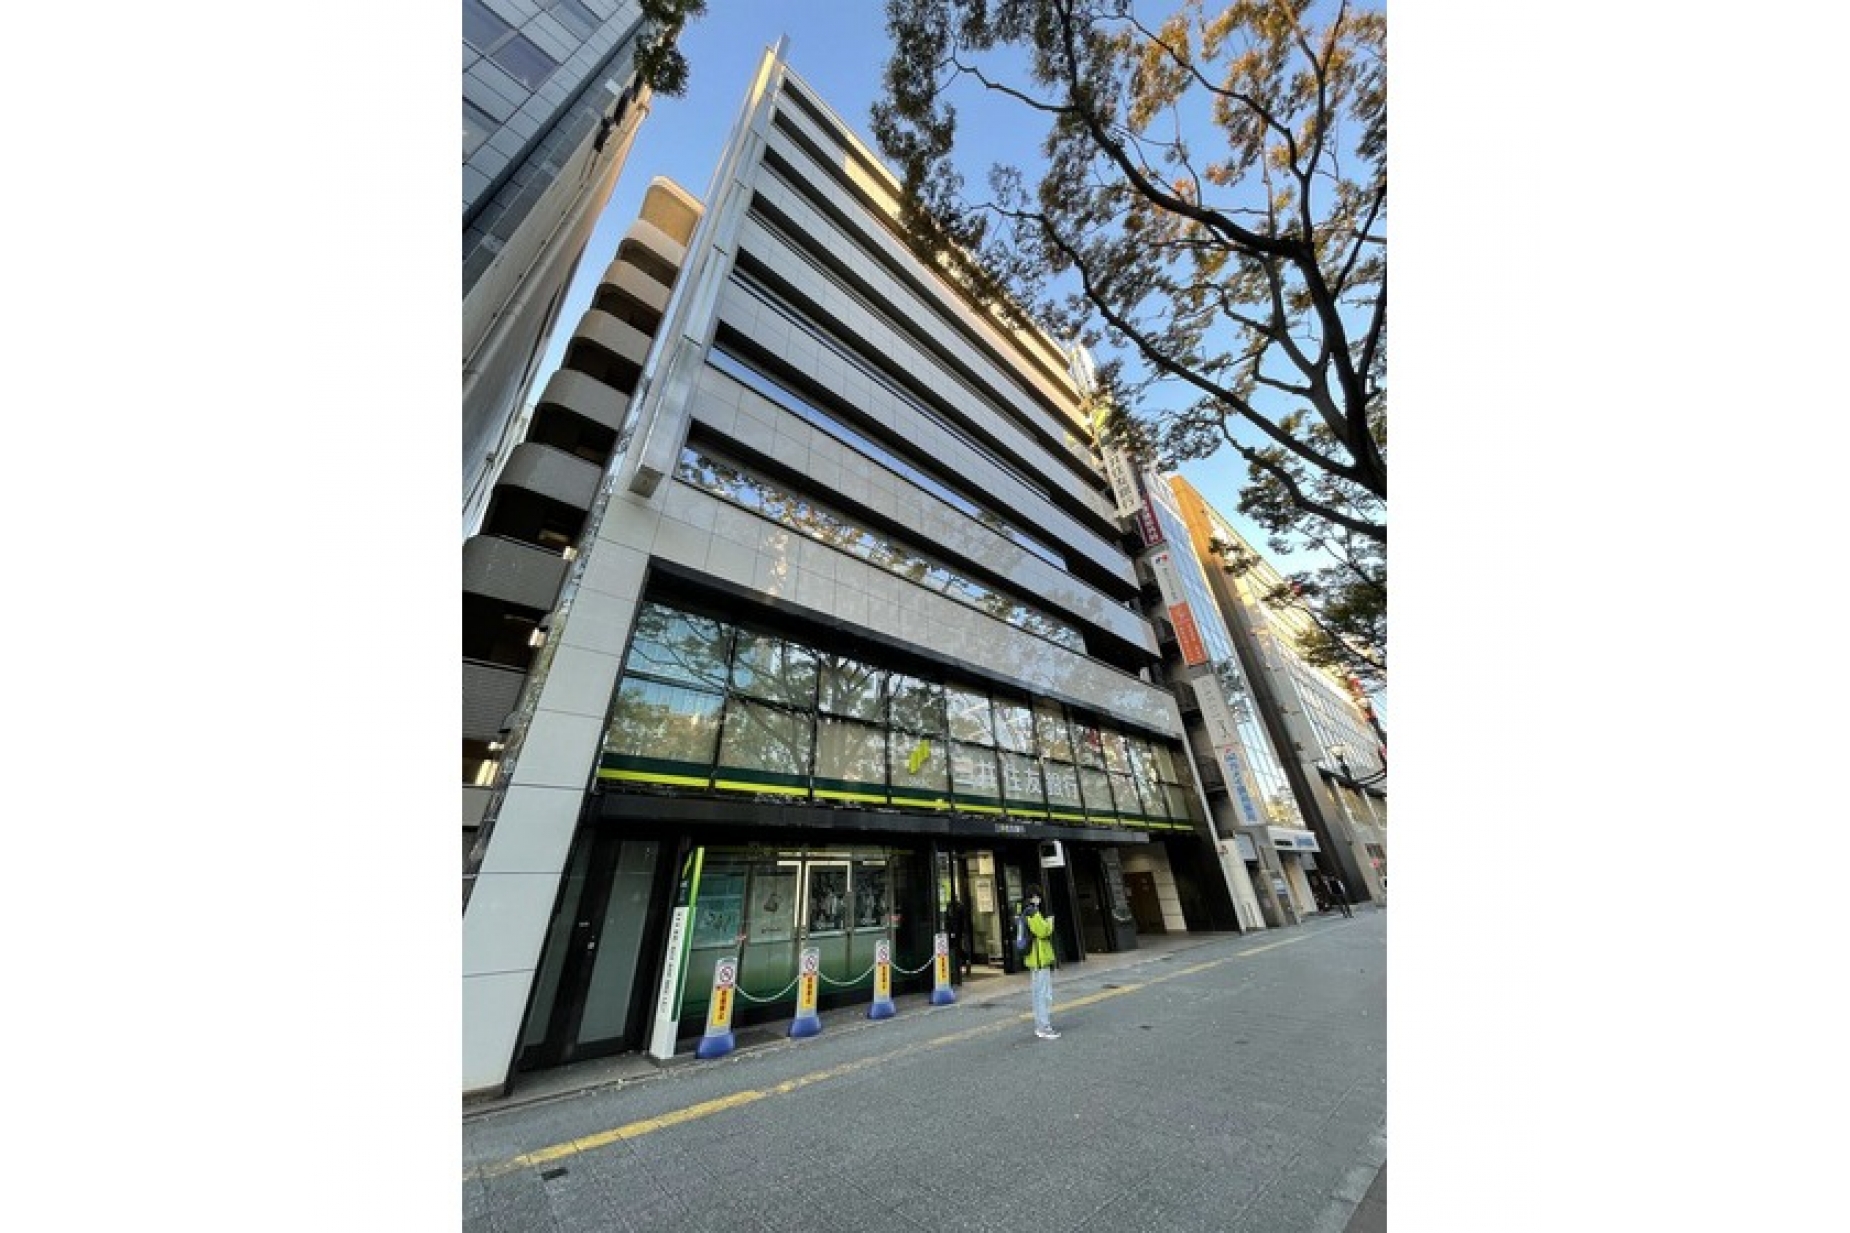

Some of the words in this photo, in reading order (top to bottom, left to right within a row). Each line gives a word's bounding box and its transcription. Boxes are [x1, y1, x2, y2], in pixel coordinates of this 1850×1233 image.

[952, 755, 1078, 795] 三井住友銀行
